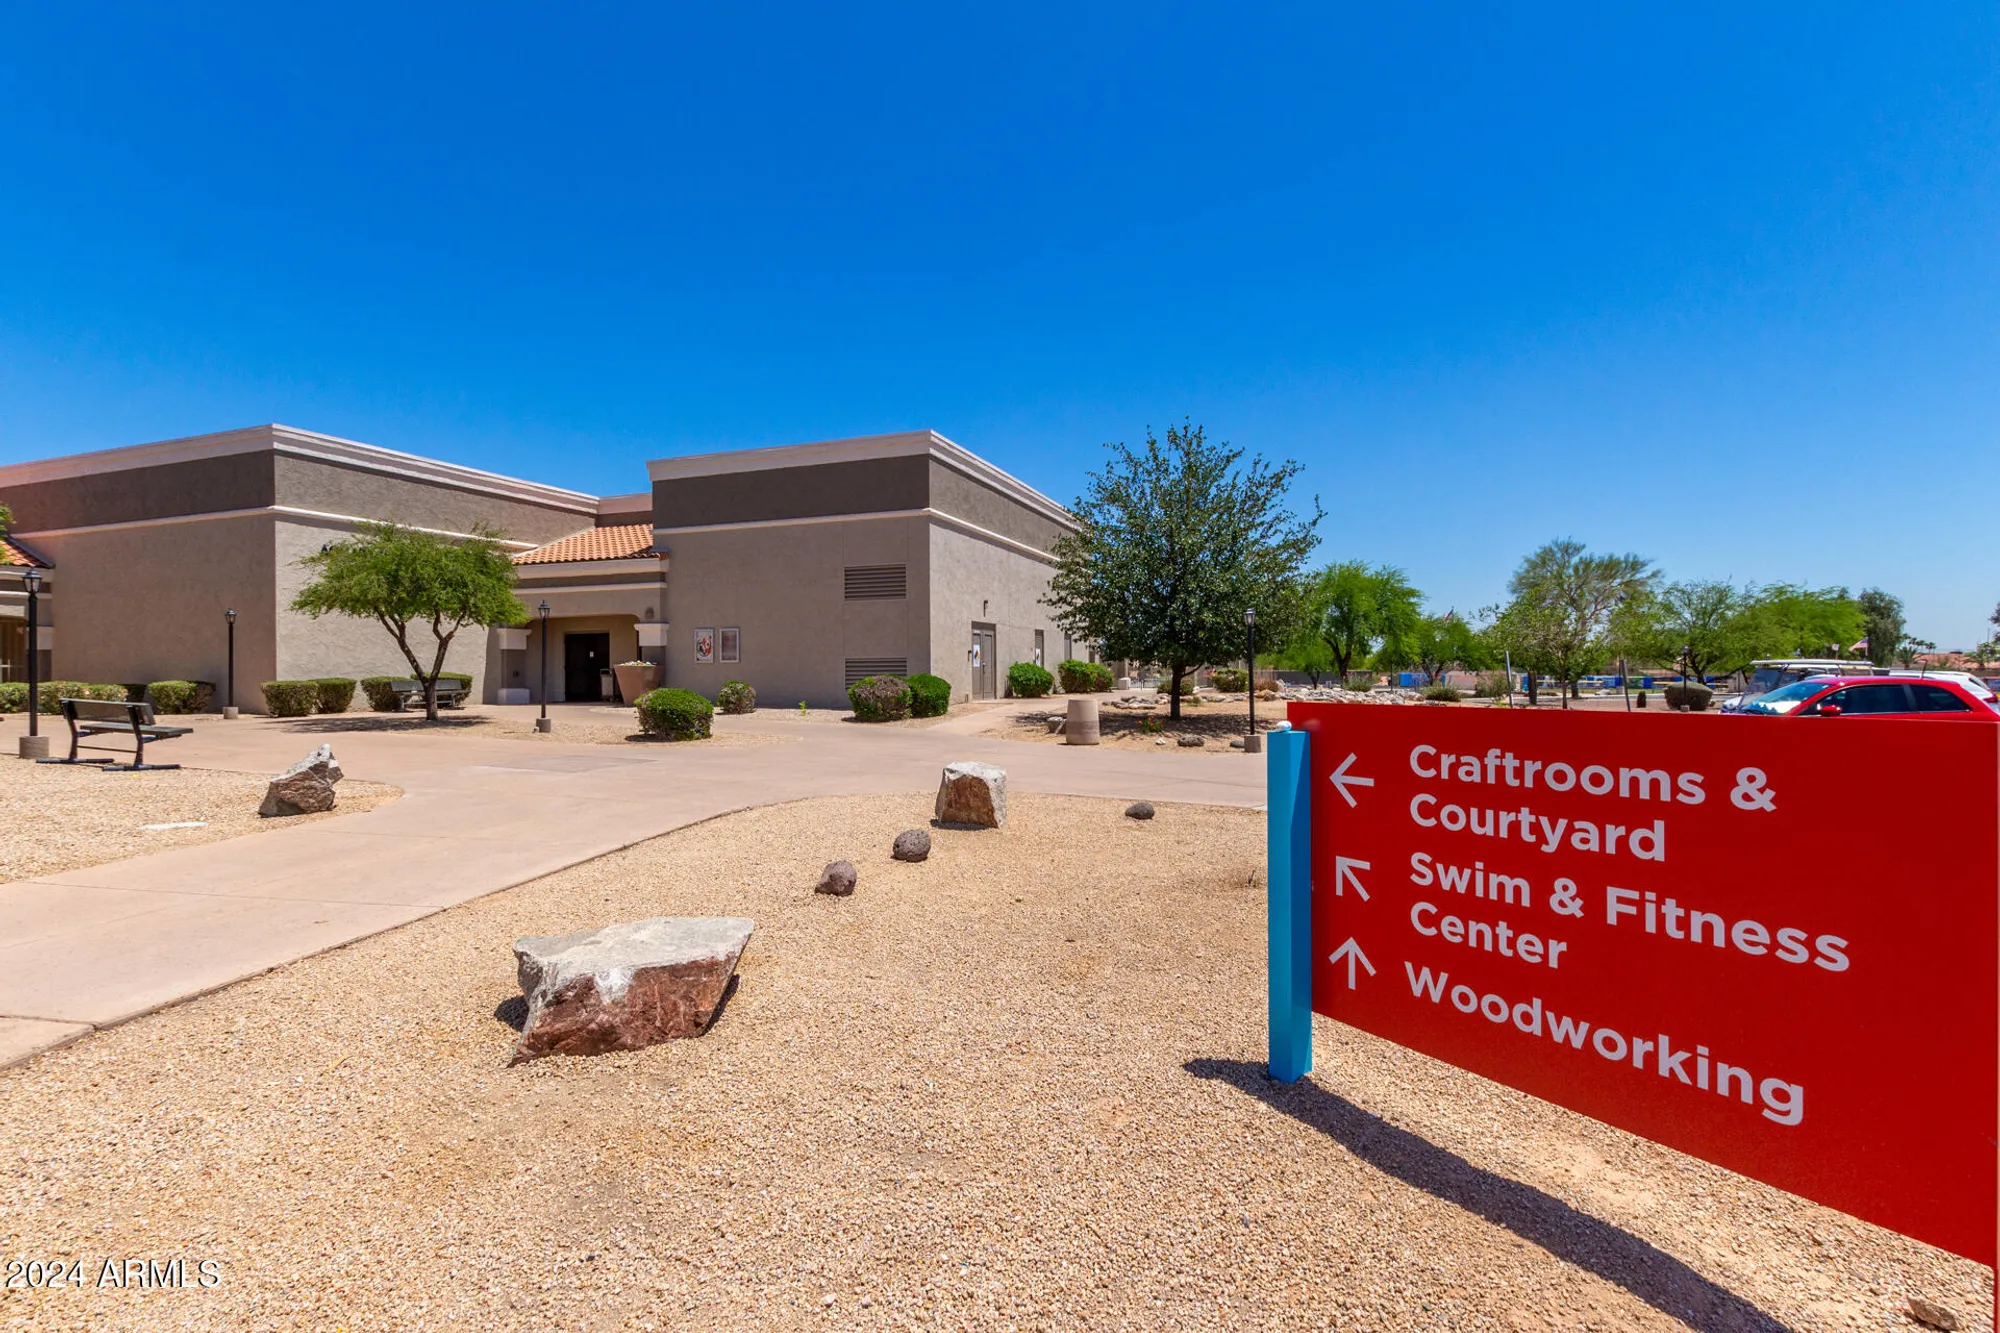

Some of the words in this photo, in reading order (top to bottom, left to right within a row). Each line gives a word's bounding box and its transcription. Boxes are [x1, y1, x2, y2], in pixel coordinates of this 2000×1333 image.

[1409, 744, 1706, 805] Craftrooms
[1730, 767, 1777, 812] &
[1409, 793, 1665, 862] Courtyard
[1410, 852, 1530, 907] Swim
[1549, 877, 1584, 918] &
[1606, 886, 1850, 972] Fitness
[1410, 901, 1567, 969] Center
[1404, 961, 1803, 1126] Woodworking
